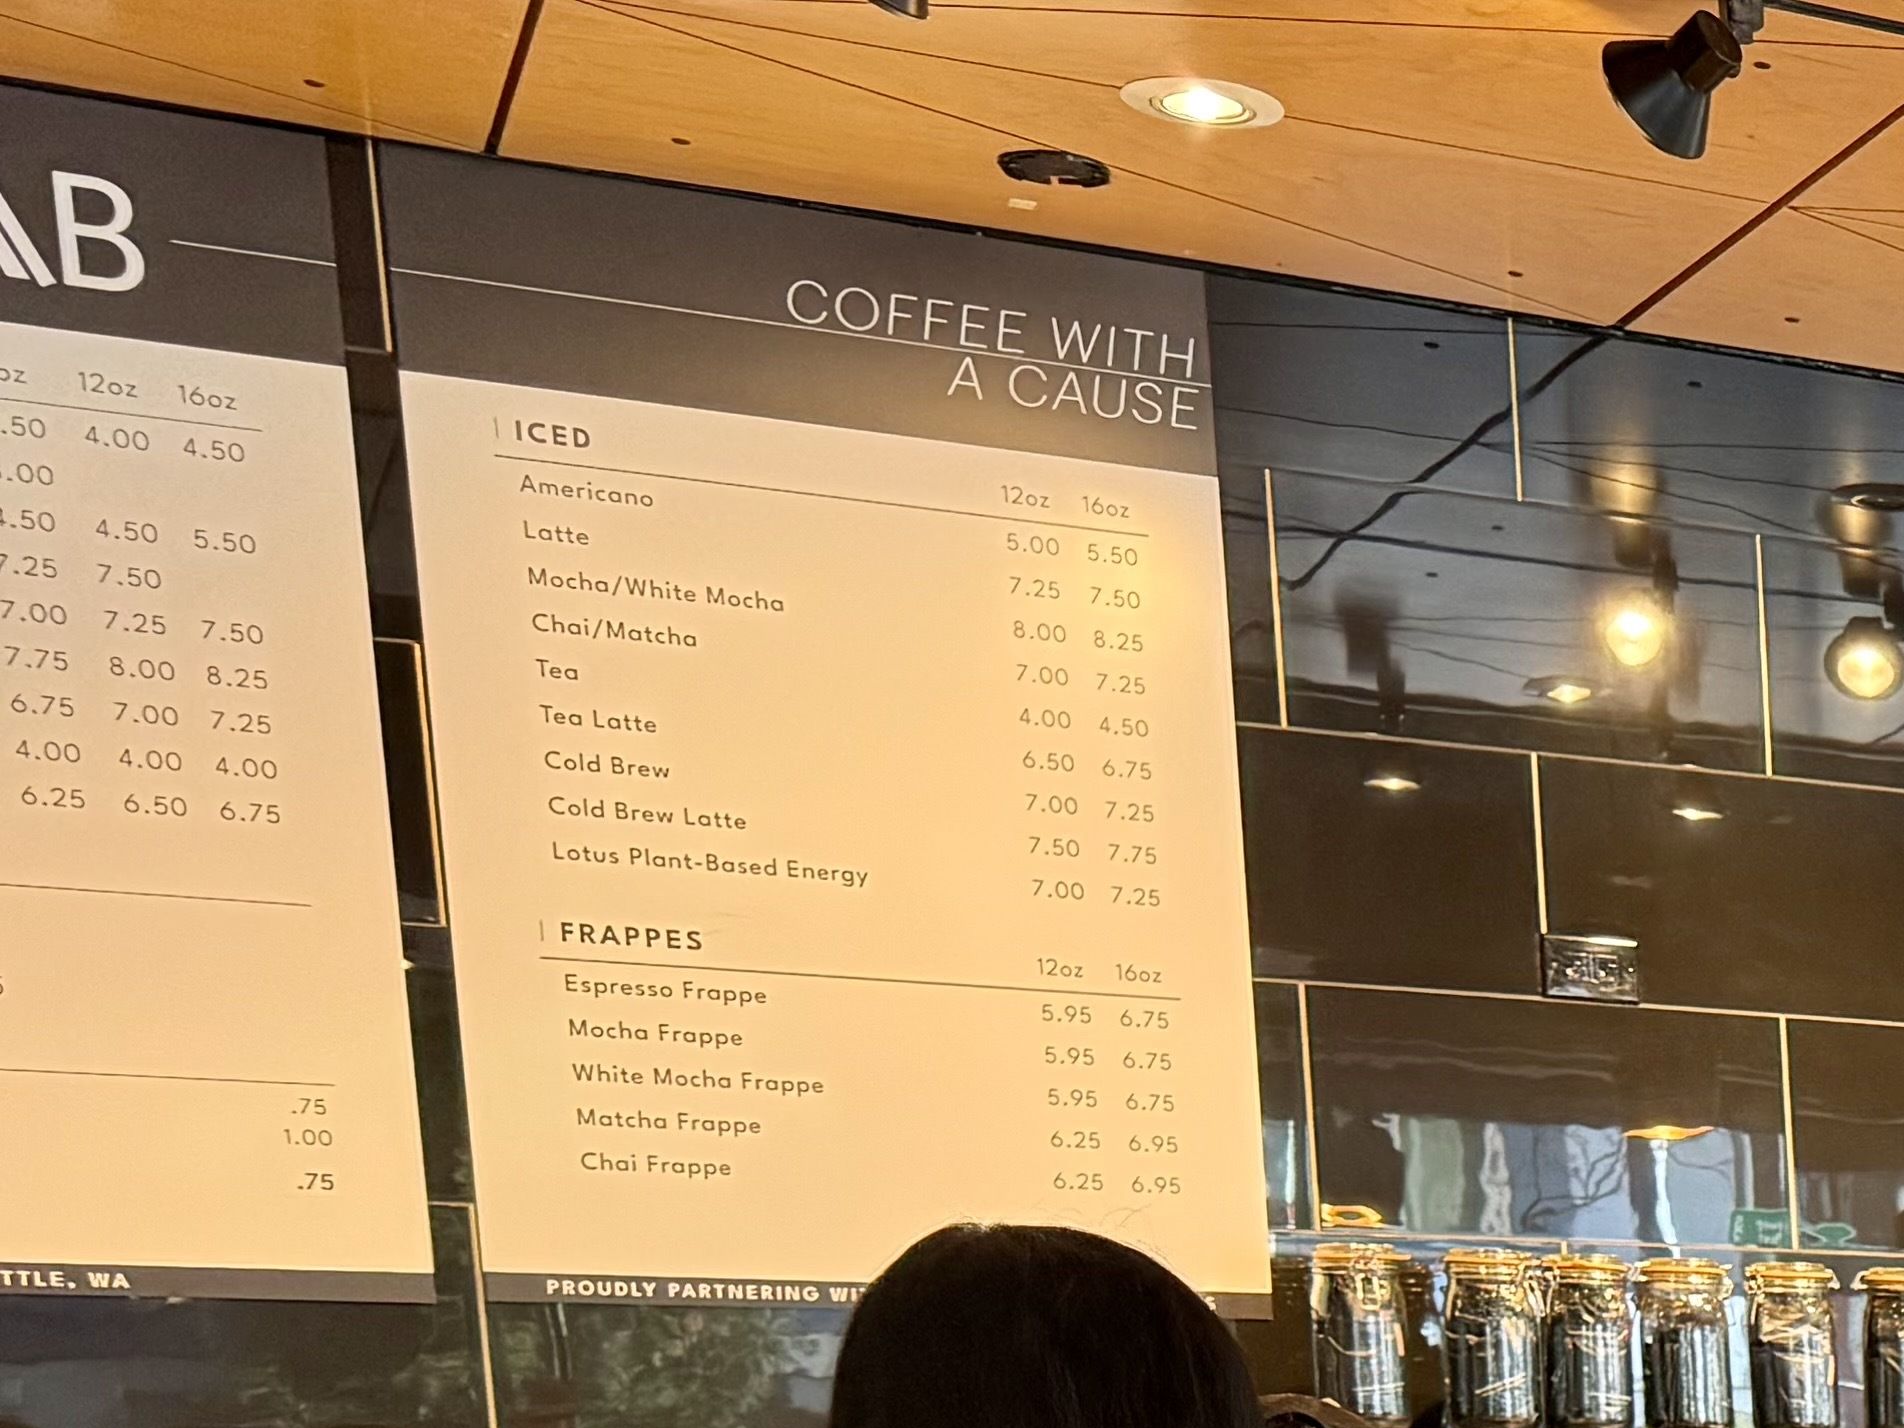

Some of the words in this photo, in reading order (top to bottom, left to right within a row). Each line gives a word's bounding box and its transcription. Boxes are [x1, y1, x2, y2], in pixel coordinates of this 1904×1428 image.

[785, 279, 1028, 355] COFFEE
[1051, 316, 1196, 379] WITH
[77, 371, 139, 399] 12oz
[177, 384, 238, 411] 16oz
[947, 356, 984, 400] A
[1008, 363, 1200, 431] CAUSE
[84, 425, 151, 452] 4.00
[182, 437, 246, 463] 4.50
[514, 419, 591, 449] ICED
[1000, 484, 1051, 509] 12oz
[1081, 495, 1131, 519] 16oz
[95, 518, 159, 545] 4.50
[193, 528, 257, 555] 5.50
[519, 473, 655, 508] Americano
[1006, 532, 1060, 557] 5.00
[1087, 543, 1138, 567] 5.50
[96, 563, 162, 590] 7.50
[522, 519, 590, 546] Latte
[1009, 575, 1061, 600] 7.25
[1090, 585, 1141, 610] 7.50
[0, 599, 68, 626] 7.00
[103, 609, 167, 636] 7.25
[200, 619, 264, 645] 7.50
[527, 566, 697, 603] Mocha/White
[705, 585, 785, 612] Mocha
[1012, 619, 1067, 644] 8.00
[1093, 629, 1144, 653] 8.25
[3, 645, 69, 672] 7.75
[109, 655, 176, 682] 8.00
[206, 665, 269, 690] 8.25
[531, 612, 697, 648] Chai/Matcha
[1016, 663, 1069, 687] 7.00
[1096, 672, 1146, 696] 7.25
[10, 692, 75, 718] 6.75
[112, 701, 179, 727] 7.00
[210, 709, 272, 735] 7.25
[534, 658, 579, 681] Tea
[1018, 707, 1072, 730] 4.00
[1099, 716, 1150, 738] 4.50
[15, 739, 81, 764] 4.00
[118, 747, 183, 772] 4.00
[215, 756, 278, 780] 4.00
[538, 703, 583, 727] Tea
[592, 709, 657, 734] Latte
[1022, 750, 1075, 773] 6.50
[1101, 758, 1152, 781] 6.75
[20, 785, 86, 810] 6.25
[123, 793, 188, 817] 6.50
[219, 800, 281, 825] 6.75
[543, 750, 601, 773] Cold
[610, 755, 670, 779] Brew
[1025, 792, 1079, 816] 7.00
[1104, 800, 1155, 823] 7.25
[547, 795, 605, 819] Cold
[614, 801, 674, 824] Brew
[683, 807, 747, 830] Latte
[1028, 835, 1080, 858] 7.50
[1107, 842, 1157, 865] 7.75
[552, 840, 620, 865] Lotus
[628, 847, 778, 877] Plant-Based
[786, 859, 869, 889] Energy
[1031, 878, 1085, 901] 7.00
[1110, 885, 1161, 908] 7.25
[560, 921, 703, 951] FRAPPES
[1036, 957, 1084, 979] 12oz
[1115, 963, 1163, 984] 16oz
[564, 973, 673, 999] Espresso
[682, 980, 767, 1008] Frappe
[1041, 1003, 1092, 1025] 5.95
[1119, 1008, 1170, 1030] 6.75
[568, 1018, 649, 1041] Mocha
[658, 1023, 743, 1050] Frappe
[1044, 1045, 1095, 1067] 5.95
[1122, 1051, 1172, 1072] 6.75
[291, 1097, 327, 1116] .75
[571, 1063, 644, 1085] White
[652, 1067, 732, 1089] Mocha
[740, 1071, 824, 1098] Frappe
[1047, 1087, 1098, 1109] 5.95
[1125, 1092, 1175, 1113] 6.75
[283, 1128, 333, 1147] 1.00
[576, 1107, 668, 1130] Matcha
[676, 1111, 761, 1138] Frappe
[1050, 1130, 1101, 1150] 6.25
[1128, 1134, 1179, 1154] 6.95
[297, 1172, 335, 1191] .75
[580, 1151, 637, 1173] Chai
[646, 1154, 731, 1181] Frappe
[1052, 1171, 1104, 1192] 6.25
[1131, 1175, 1181, 1195] 6.95
[88, 1271, 131, 1289] WA
[546, 1278, 657, 1298] PROUDLY
[667, 1282, 820, 1302] PARTNERING
[829, 1286, 866, 1303] WI
